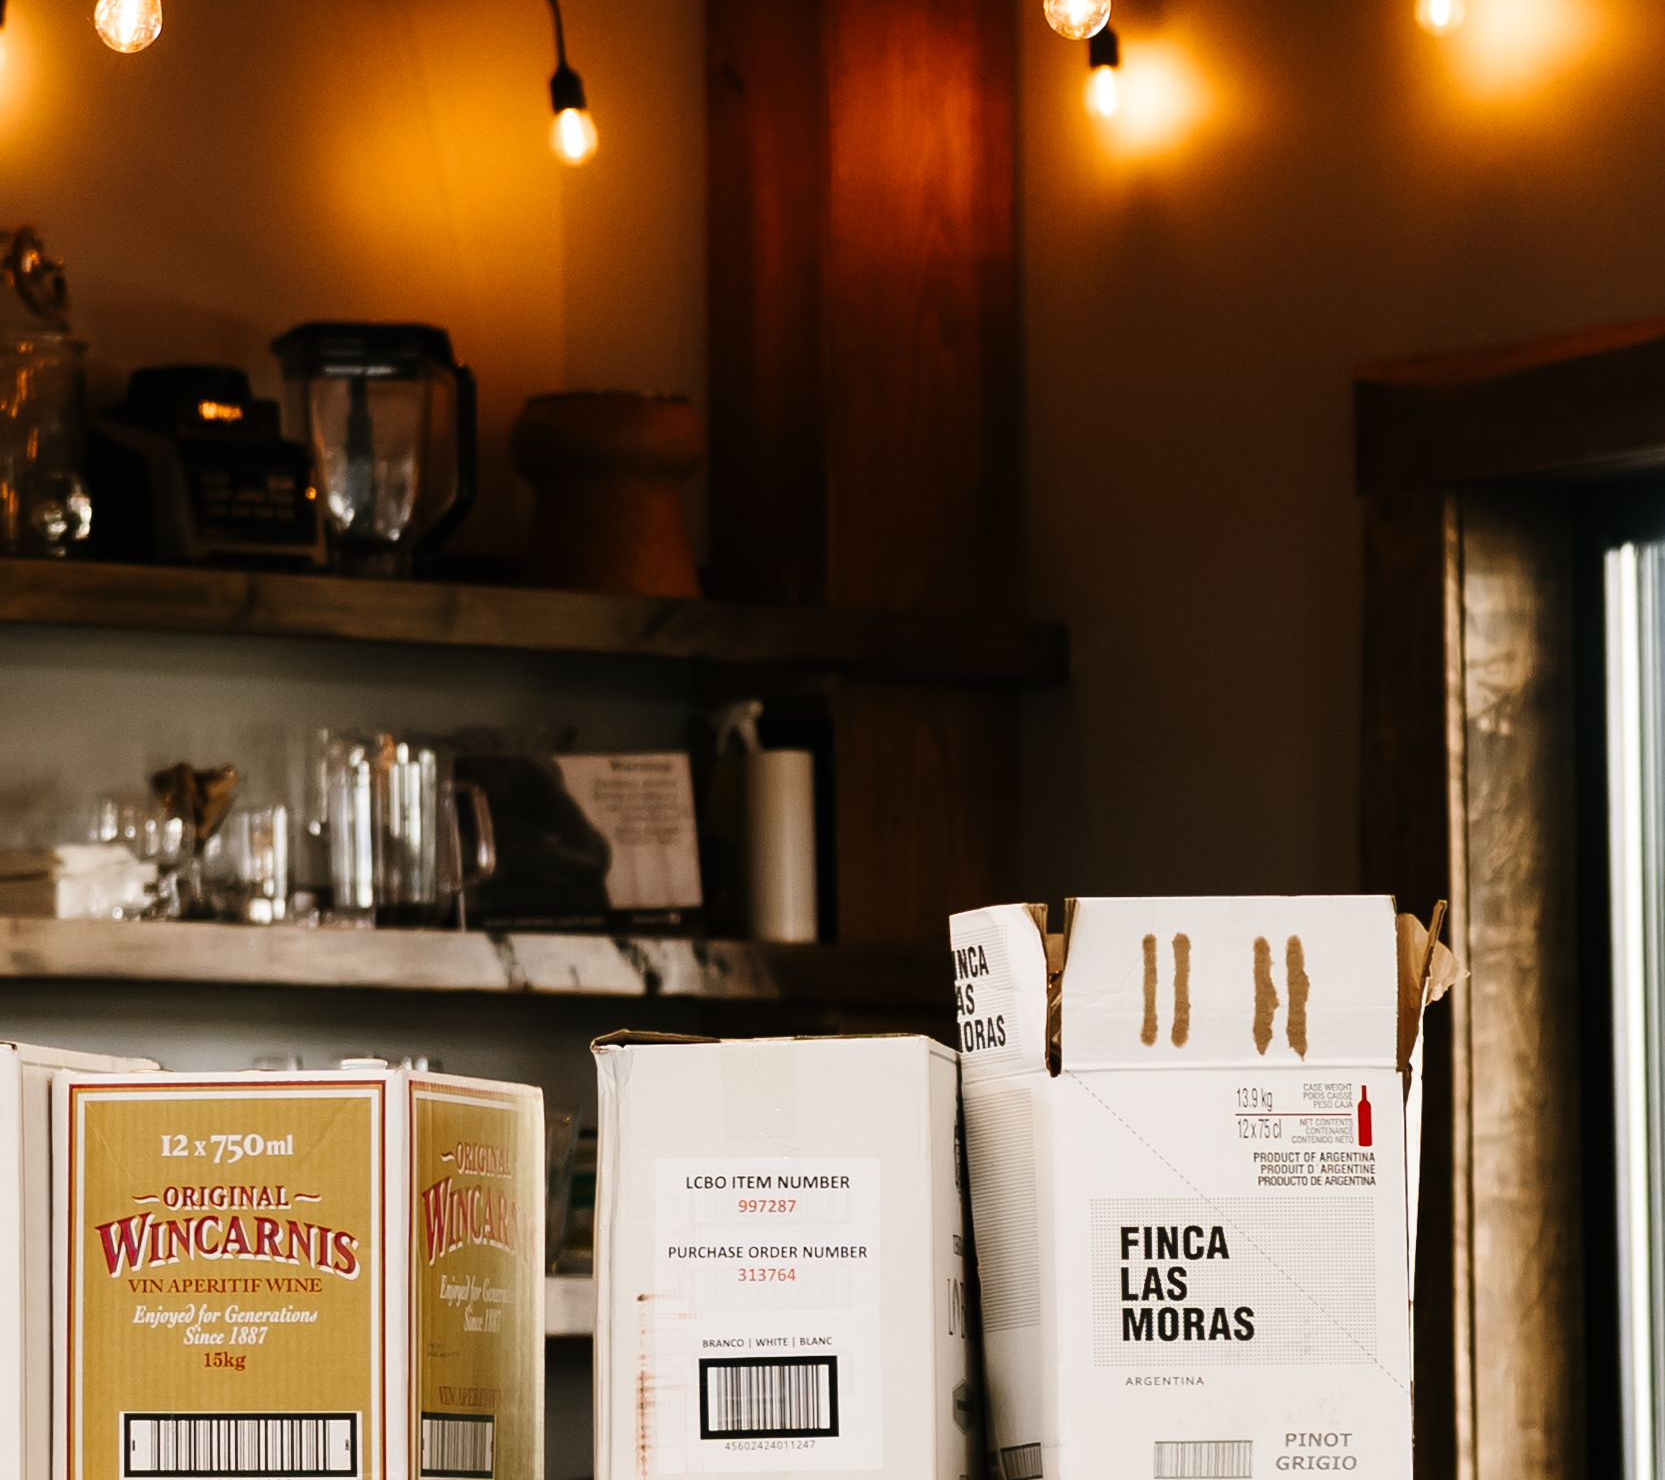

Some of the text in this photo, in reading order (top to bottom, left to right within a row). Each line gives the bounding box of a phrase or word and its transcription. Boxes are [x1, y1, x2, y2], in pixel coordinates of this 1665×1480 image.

[953, 945, 989, 980] INCA
[956, 984, 975, 1015] AS
[1303, 1083, 1353, 1091] CASE WEIGHT
[1237, 1088, 1273, 1112] 13.9 kg
[1303, 1092, 1353, 1100] POIDS CAISSE
[1313, 1101, 1333, 1109] PESO
[161, 1134, 189, 1157] 12
[193, 1141, 207, 1157] x
[455, 1141, 513, 1179] ORIGINAL
[1253, 1152, 1376, 1163] PRODUCT OF ARGENTINA
[1260, 1164, 1304, 1174] PRODUIT
[1320, 1164, 1376, 1174] ARGENTINE
[686, 1176, 850, 1189] LCBO ITEM NUMBER
[1258, 1176, 1376, 1186] PRODUCTO DE ARGENTINA
[163, 1185, 292, 1211] ORIGINAL
[738, 1199, 796, 1213] 997287
[422, 1176, 540, 1273] WINCAR
[95, 1211, 361, 1281] WINCARNIS
[1121, 1225, 1230, 1260] FINCA
[668, 1246, 867, 1259] PURCHASE ORDER NUMBER
[738, 1268, 796, 1281] 313764
[129, 1278, 323, 1293] VIN APERITIF WINE
[1121, 1266, 1188, 1301] LAS
[133, 1304, 318, 1329] Enjoyed for Generations
[1122, 1306, 1255, 1341] MORAS
[183, 1326, 268, 1345] Since 1887
[702, 1339, 744, 1348] BRANCO
[755, 1337, 789, 1347] WHITE
[800, 1336, 833, 1346] BLANC
[204, 1352, 246, 1371] 15kg
[1125, 1376, 1205, 1386] ARGENTINA
[724, 1440, 816, 1451] 45602424011247
[1285, 1433, 1353, 1447] PINOT
[1275, 1456, 1357, 1471] GRIGIO
